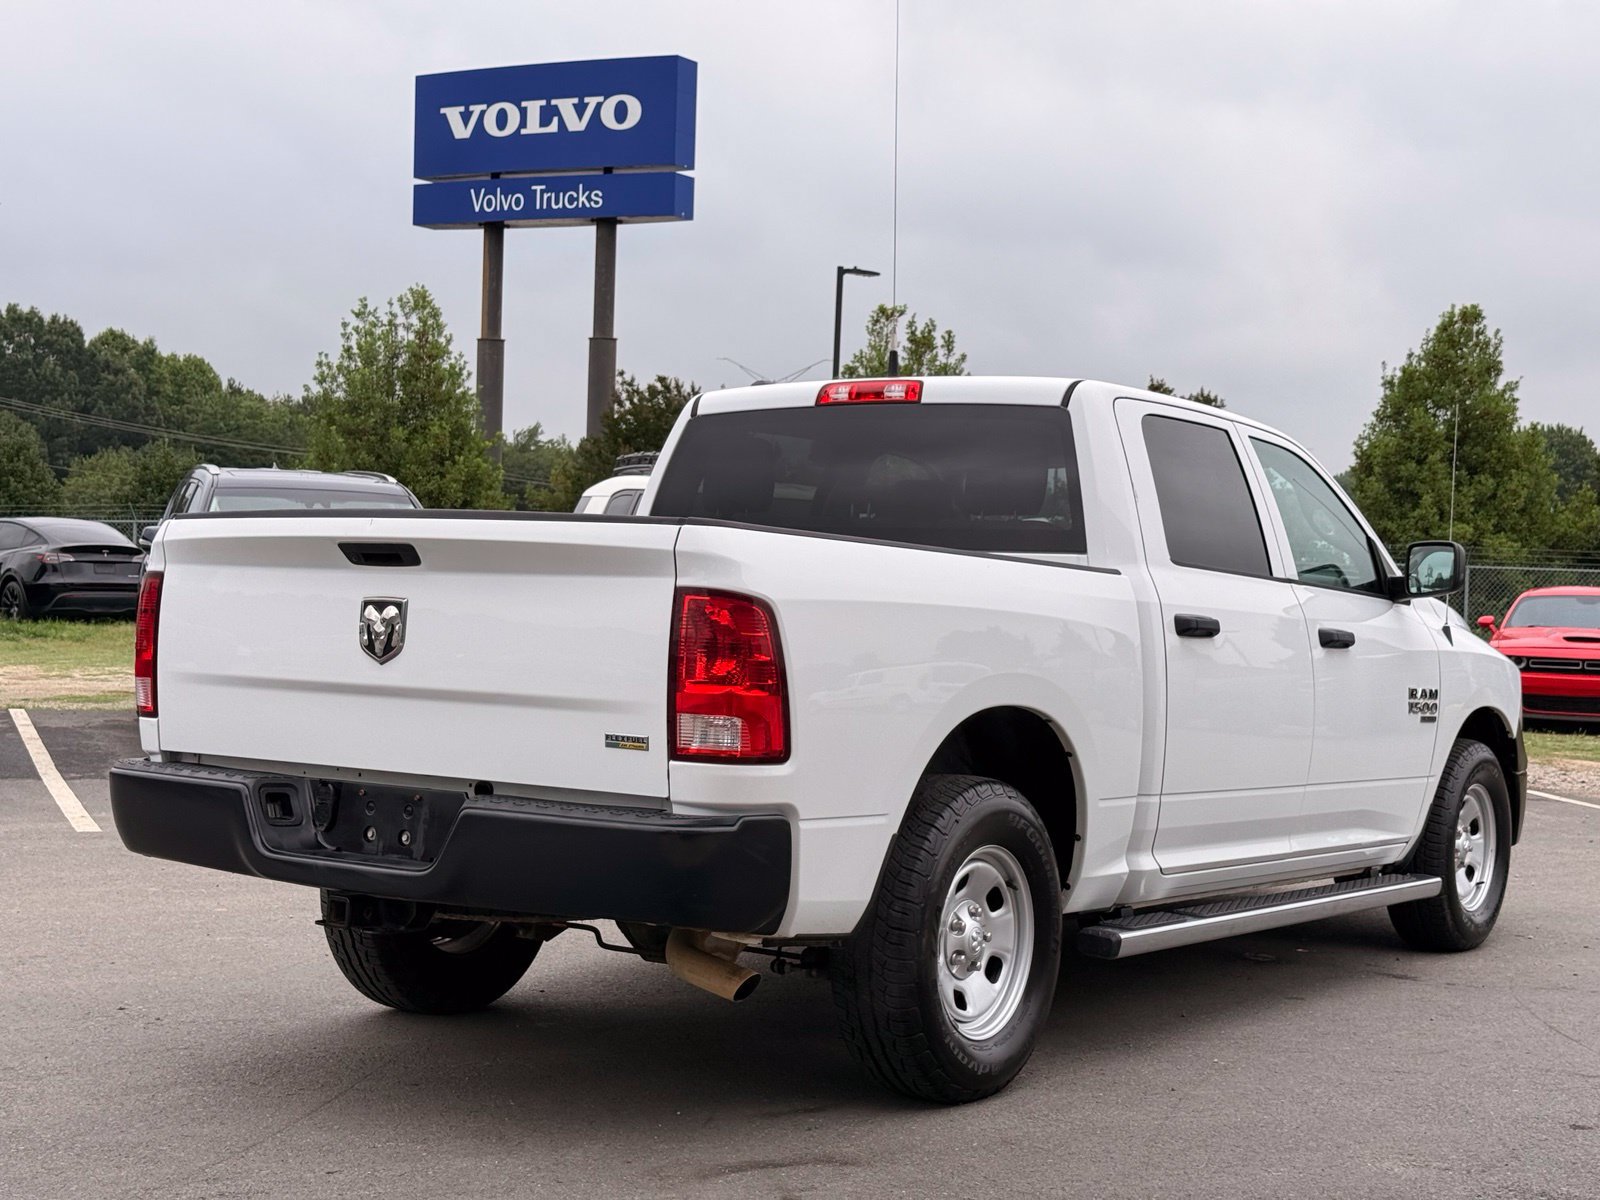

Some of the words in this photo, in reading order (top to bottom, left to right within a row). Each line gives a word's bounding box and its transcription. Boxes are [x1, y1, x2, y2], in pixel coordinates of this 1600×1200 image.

[440, 93, 642, 139] VOLVO
[470, 186, 525, 213] Volvo
[531, 184, 603, 210] Trucks
[1408, 687, 1438, 700] RAM
[1408, 701, 1438, 715] 1500
